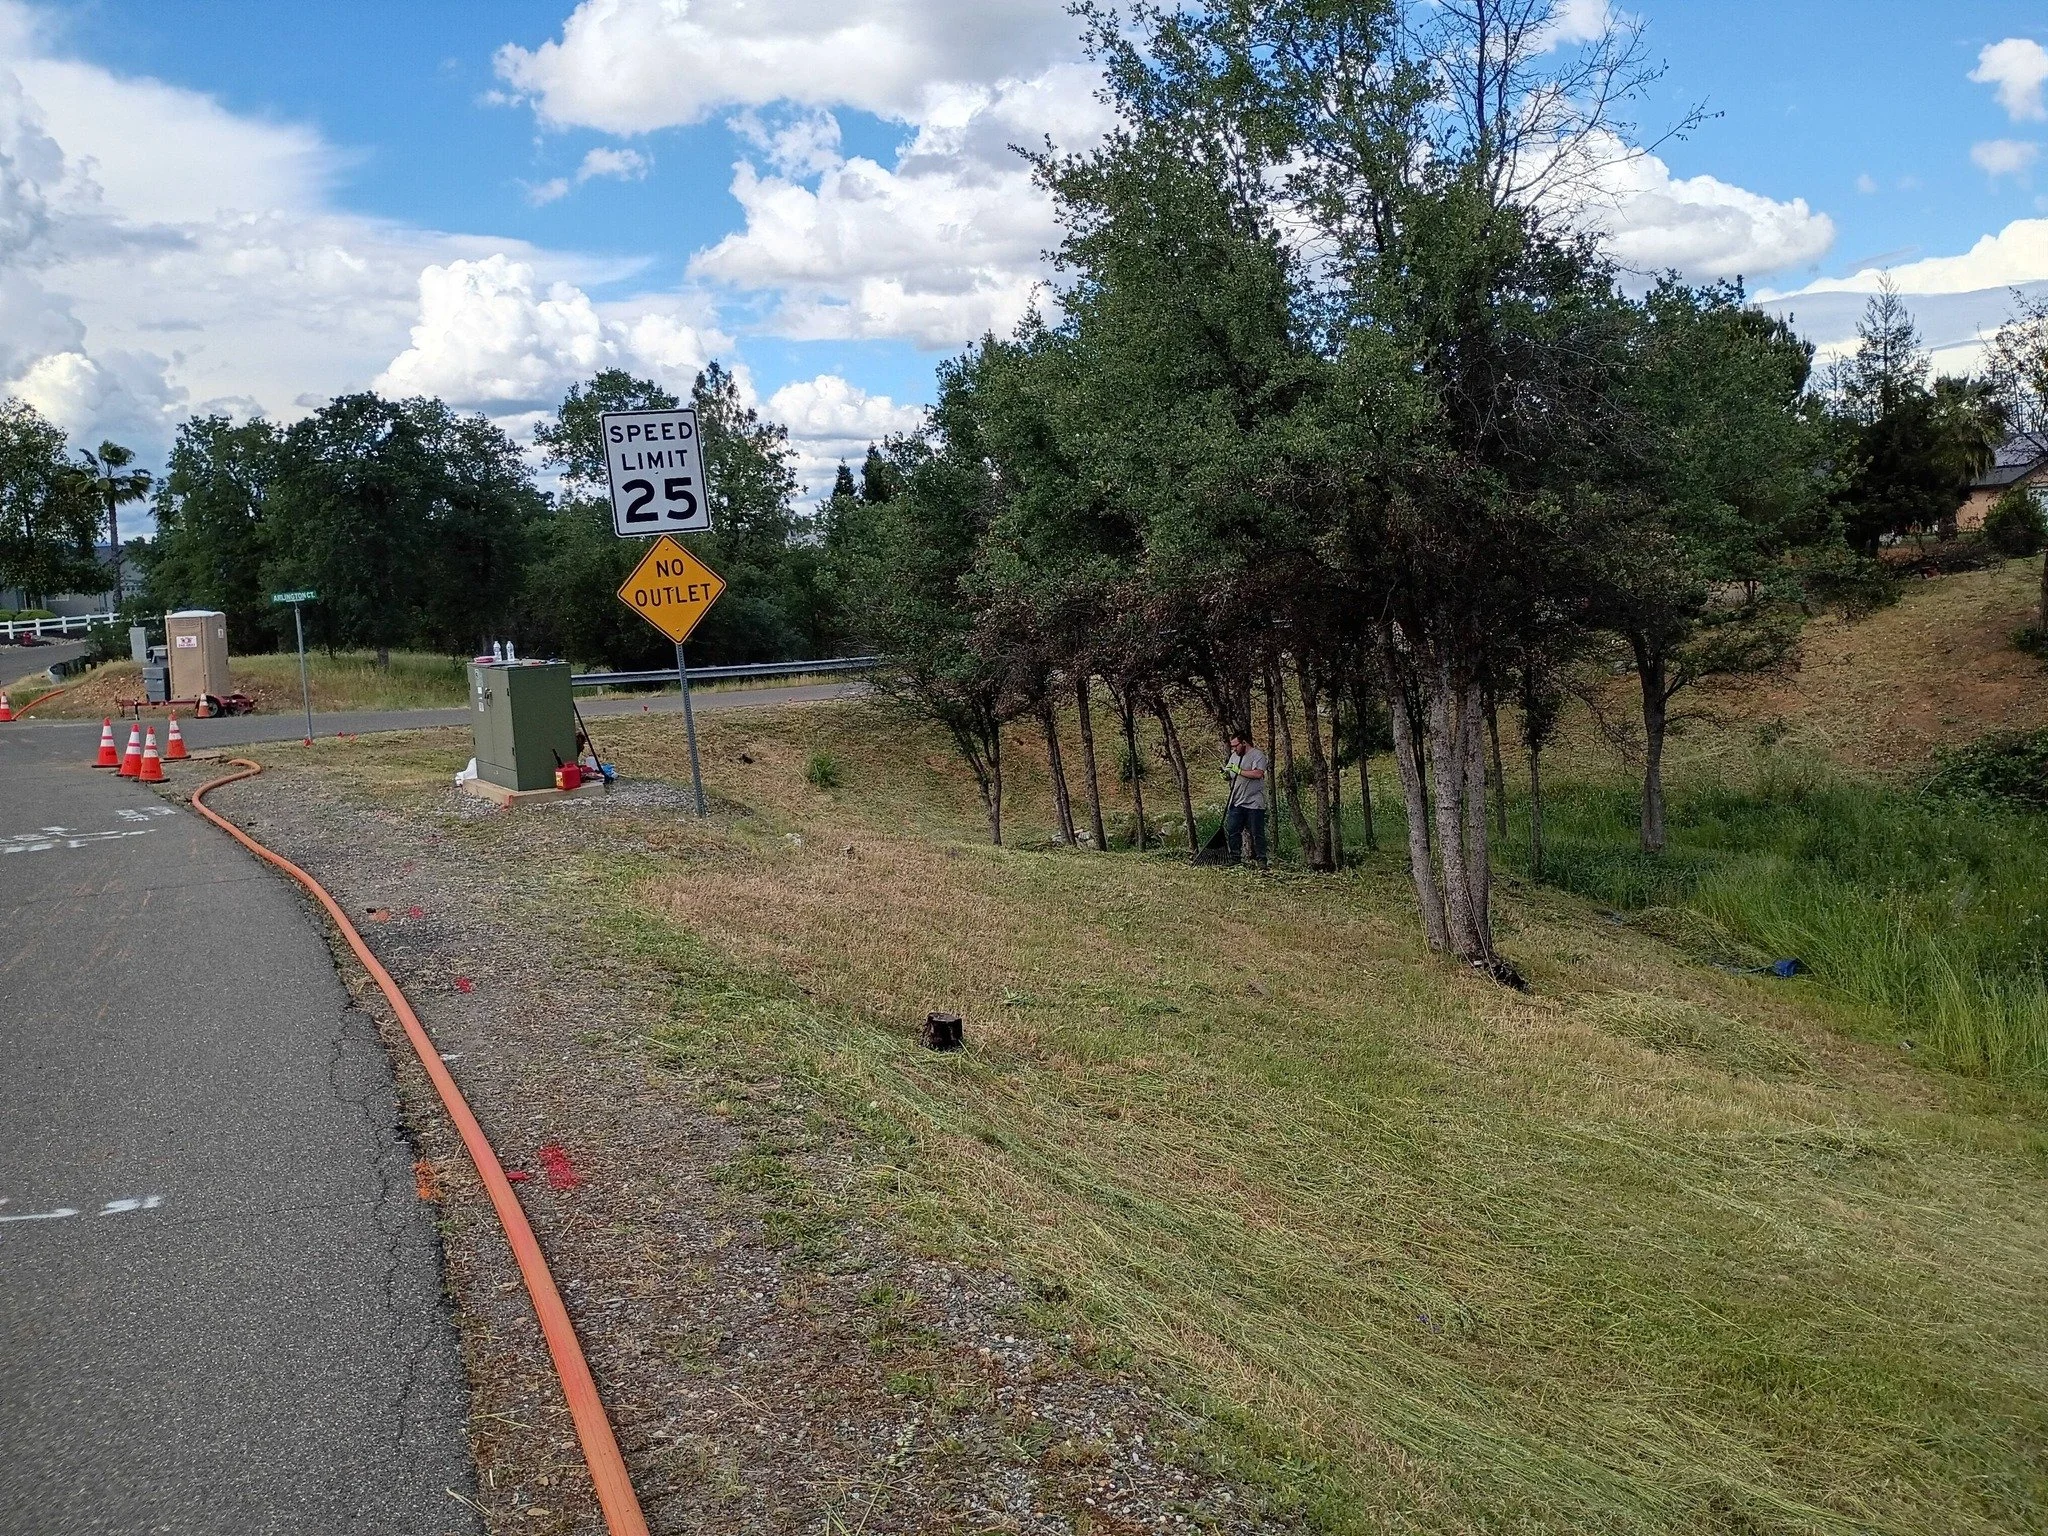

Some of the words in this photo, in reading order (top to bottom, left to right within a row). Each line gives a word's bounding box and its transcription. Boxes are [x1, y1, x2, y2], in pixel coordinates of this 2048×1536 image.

[610, 422, 693, 443] SPEED
[621, 450, 688, 471] LIMIT
[621, 477, 698, 523] 25
[656, 559, 684, 578] NO
[273, 592, 306, 601] ARLINGTON
[635, 583, 710, 607] OUTLET
